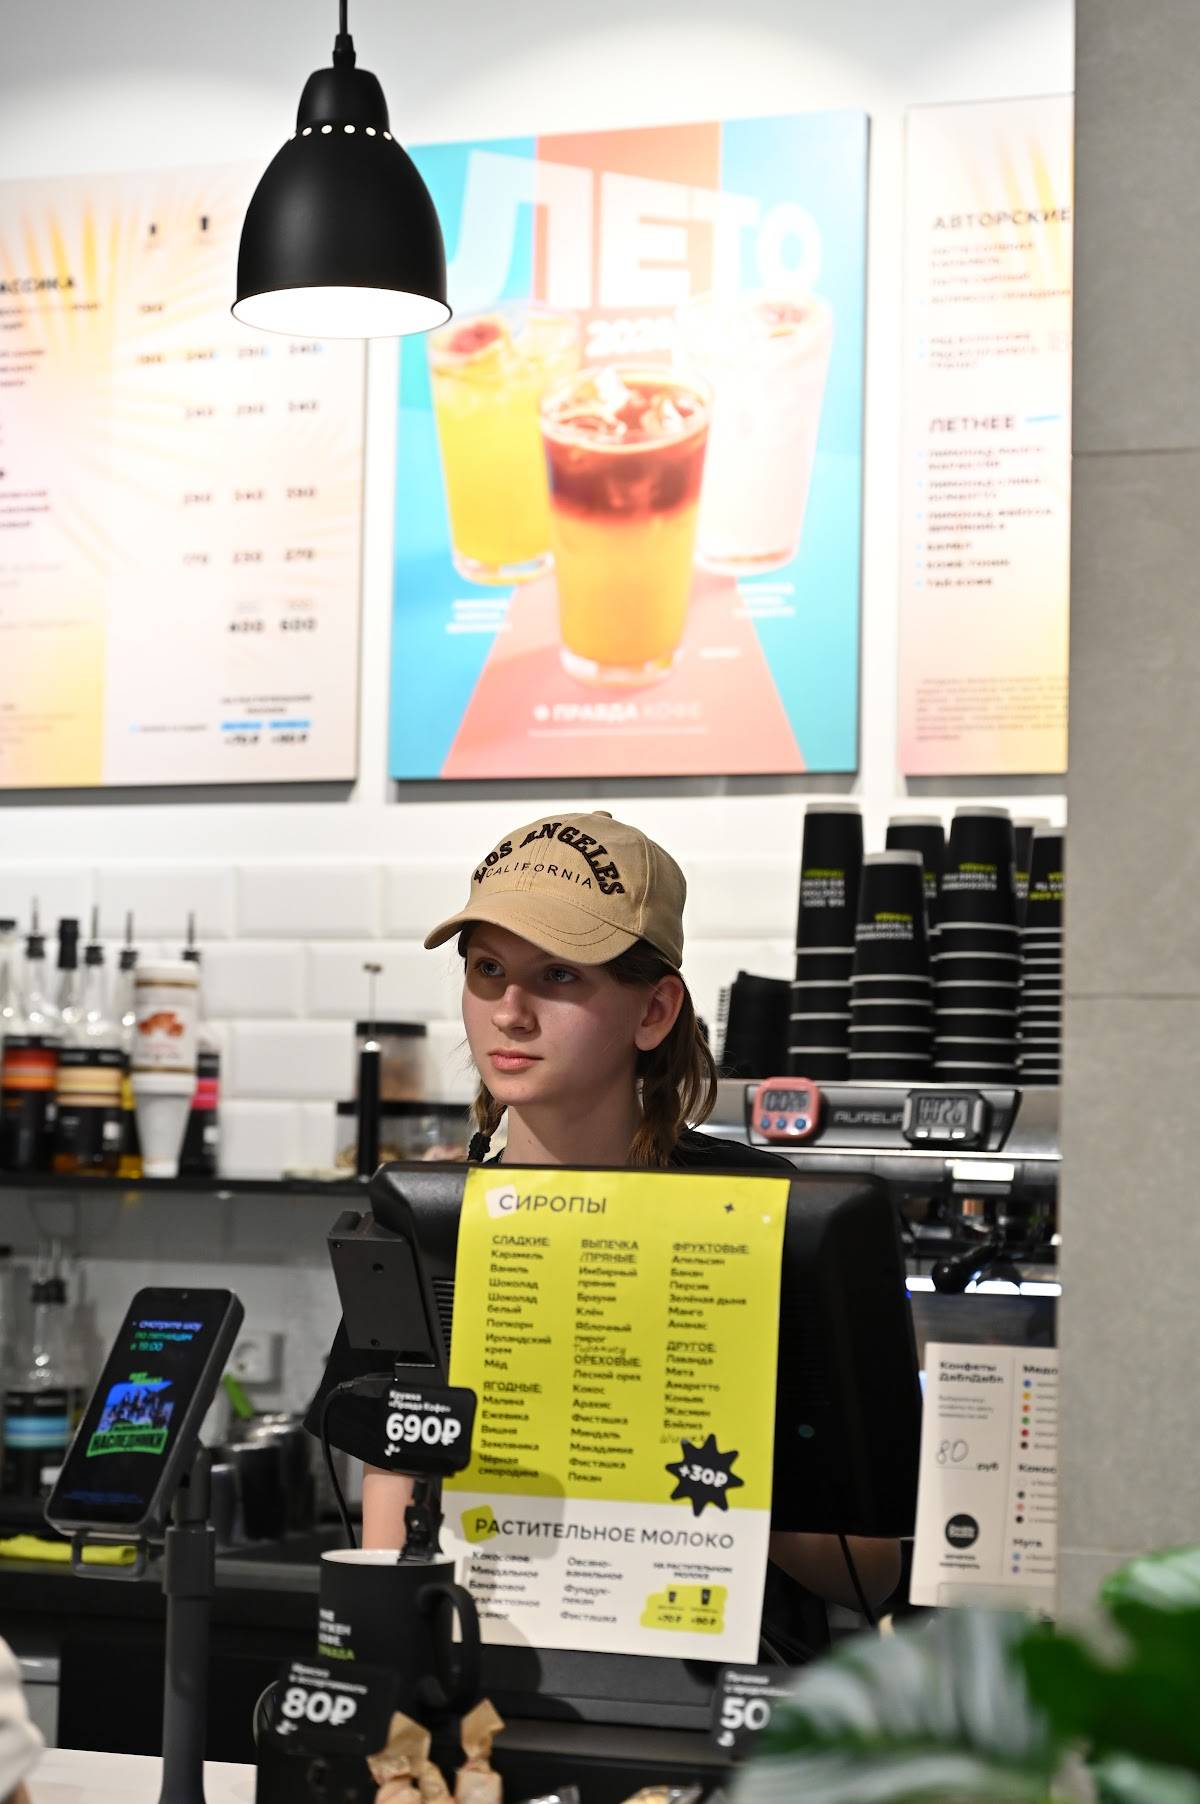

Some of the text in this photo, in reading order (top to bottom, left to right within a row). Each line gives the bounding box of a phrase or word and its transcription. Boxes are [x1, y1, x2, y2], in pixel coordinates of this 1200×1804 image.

[445, 149, 822, 311] ЛЕТО
[933, 206, 1072, 230] АВТОРСКИЕ
[929, 415, 1016, 433] ЛЕТНЕЕ
[552, 703, 639, 723] ПРАВДА
[474, 822, 625, 895] LOS ANGELES
[486, 862, 592, 889] CALIFORNIA
[499, 1194, 607, 1214] СИРОПЫ
[386, 1412, 461, 1446] 690₽
[475, 1517, 734, 1549] РАСТИТЕЛЬНОЕ МОЛОКО
[281, 1687, 357, 1727] 80₽
[720, 1696, 771, 1731] 50
